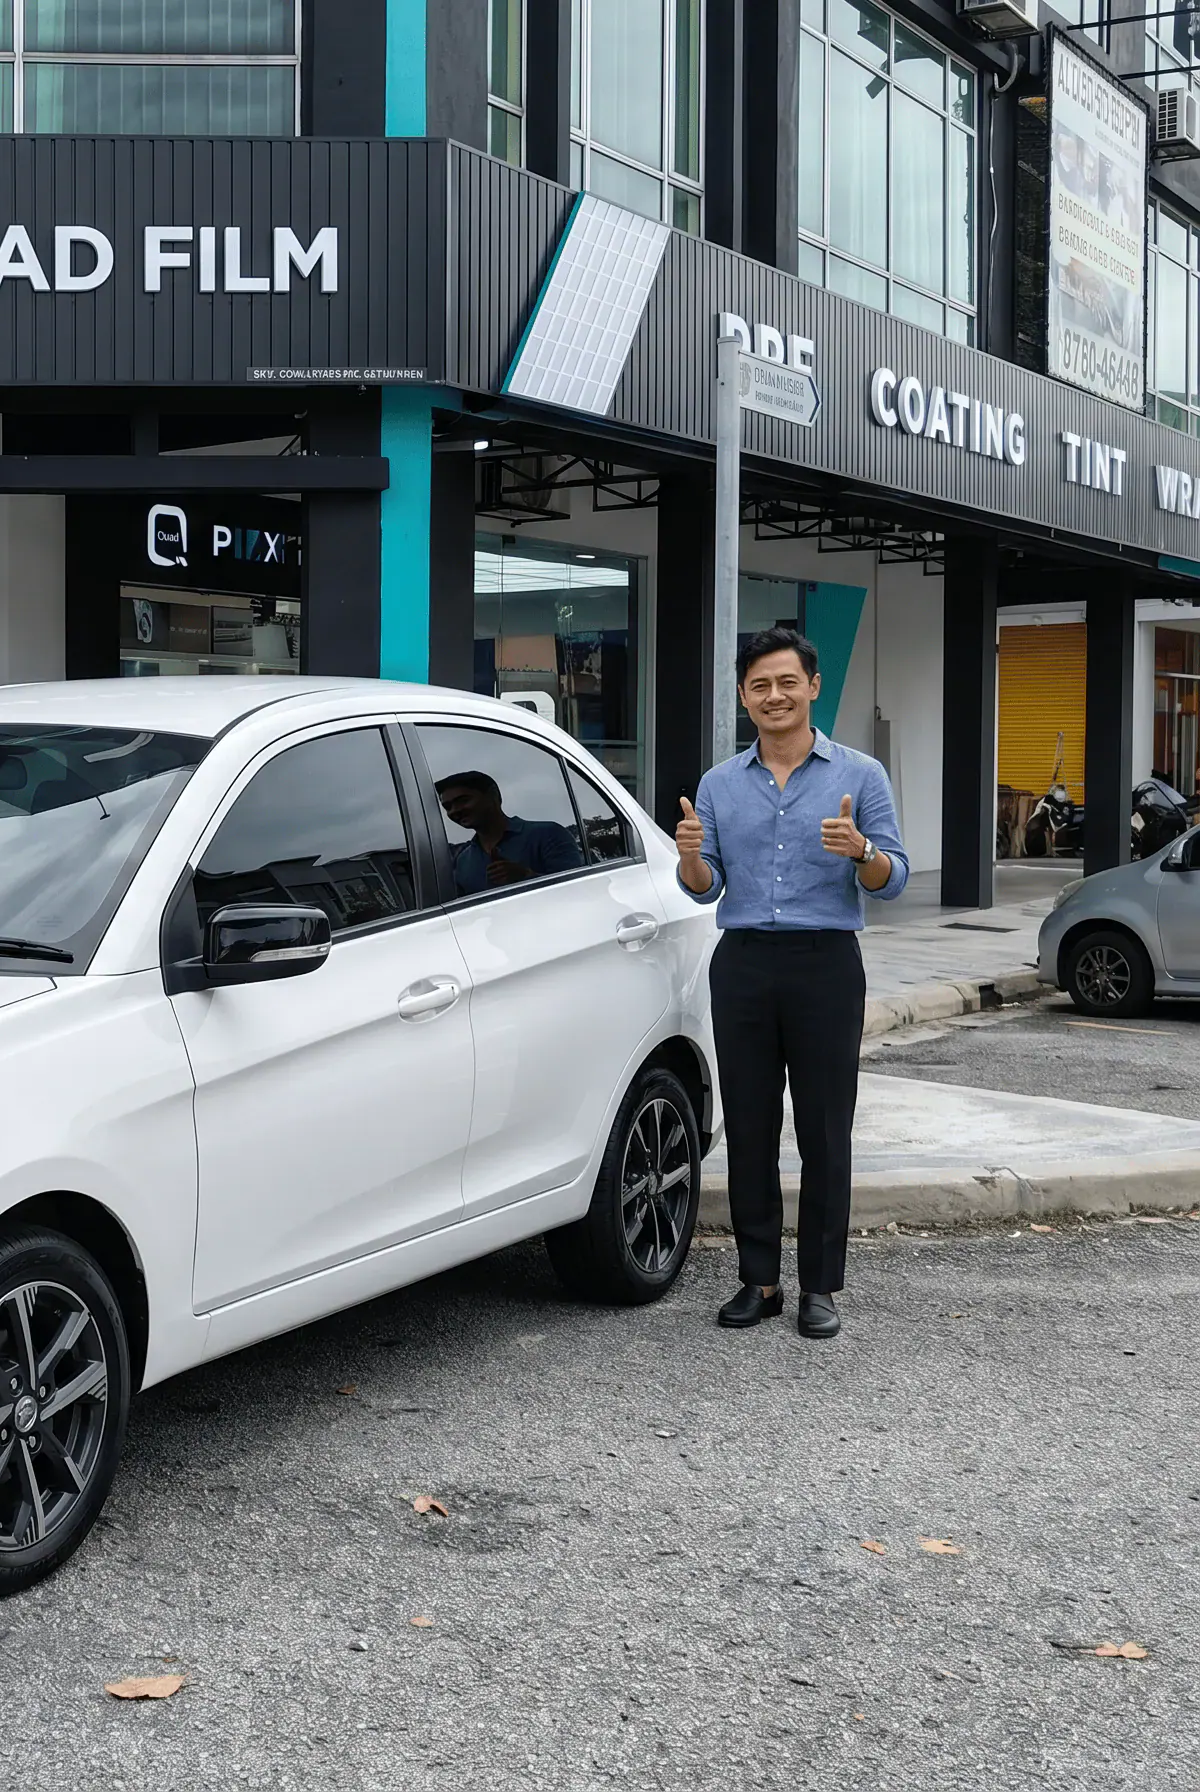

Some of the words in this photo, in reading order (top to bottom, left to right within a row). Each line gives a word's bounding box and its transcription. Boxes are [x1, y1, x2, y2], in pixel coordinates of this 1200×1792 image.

[144, 226, 339, 293] FILM
[871, 368, 1025, 466] COATING
[1061, 431, 1127, 496] TINT
